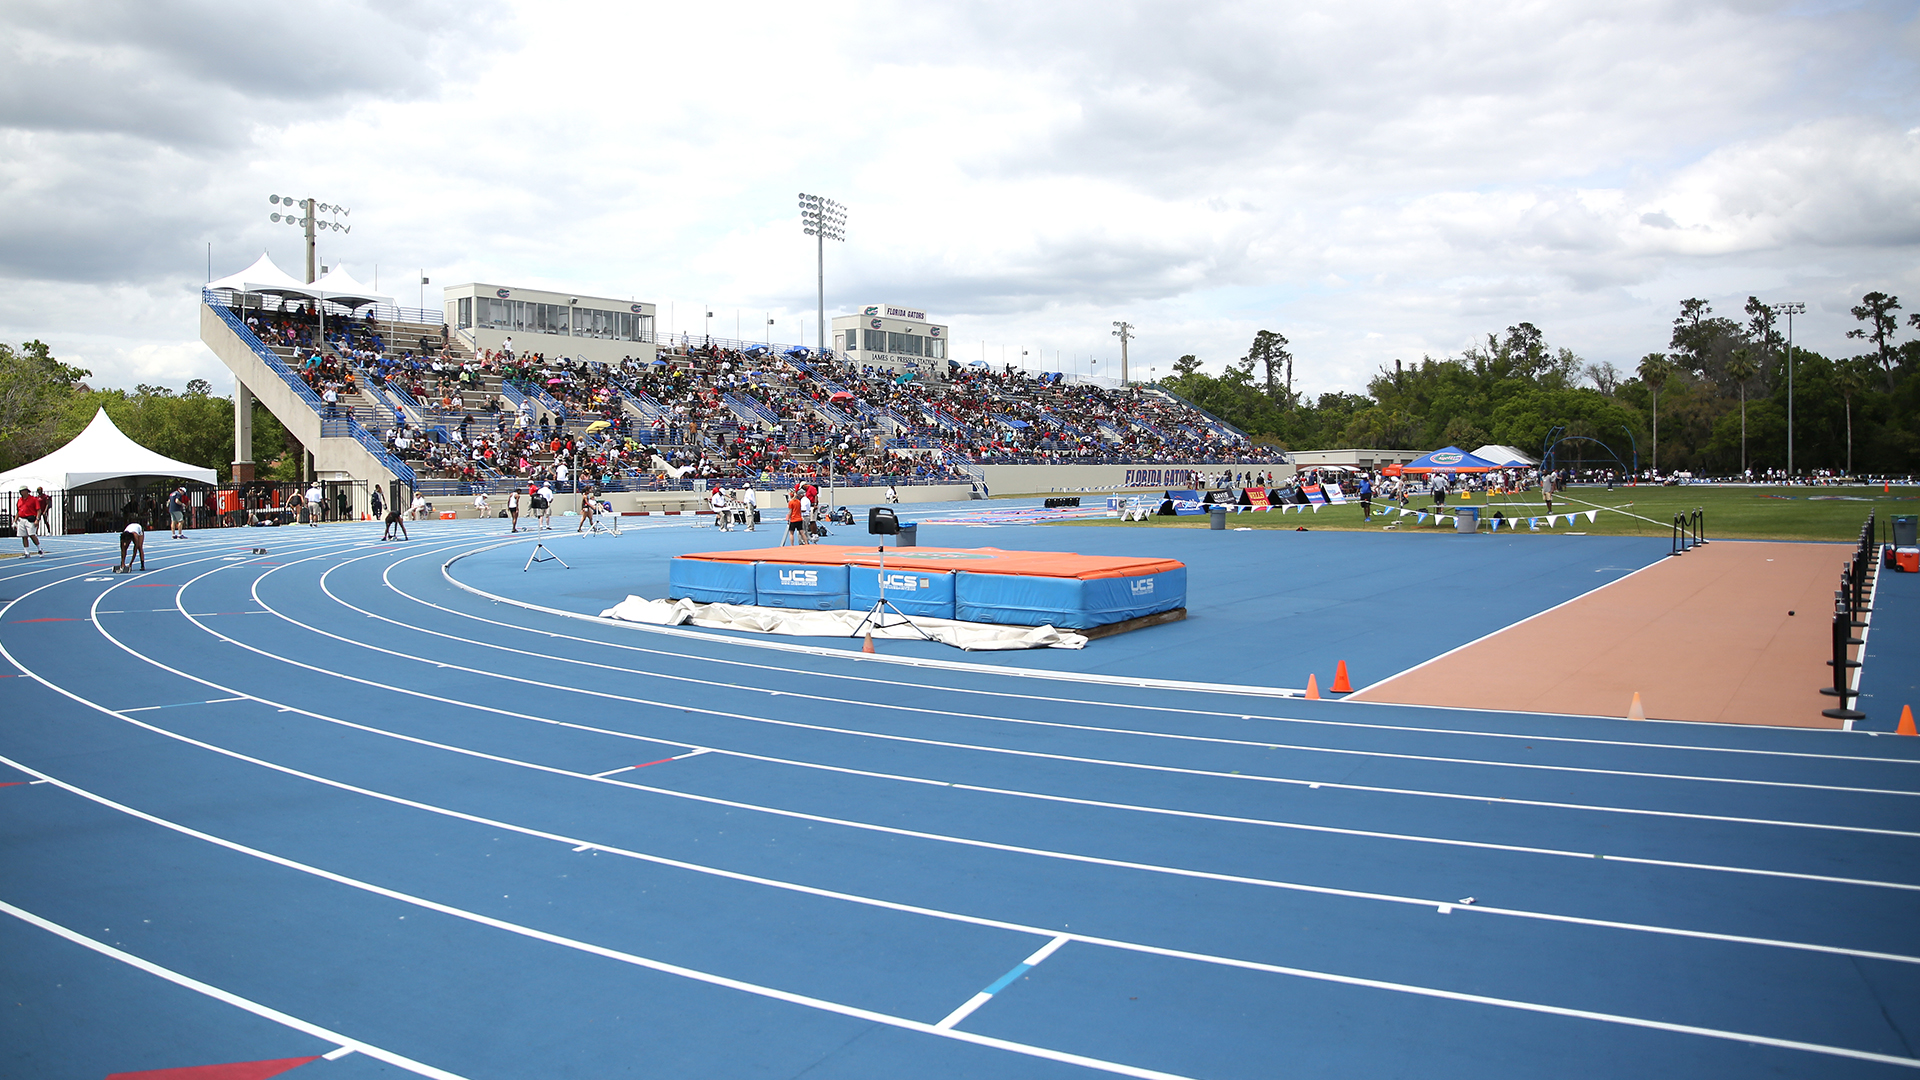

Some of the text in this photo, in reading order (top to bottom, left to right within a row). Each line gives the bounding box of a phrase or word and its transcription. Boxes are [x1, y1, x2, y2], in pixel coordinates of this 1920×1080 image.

[887, 307, 924, 319] FLORIDA GATORS
[1125, 469, 1162, 488] FLORIDA
[1248, 491, 1266, 500] WELLS
[779, 569, 818, 582] UCS
[877, 573, 918, 587] UCS
[1130, 578, 1154, 592] UCS
